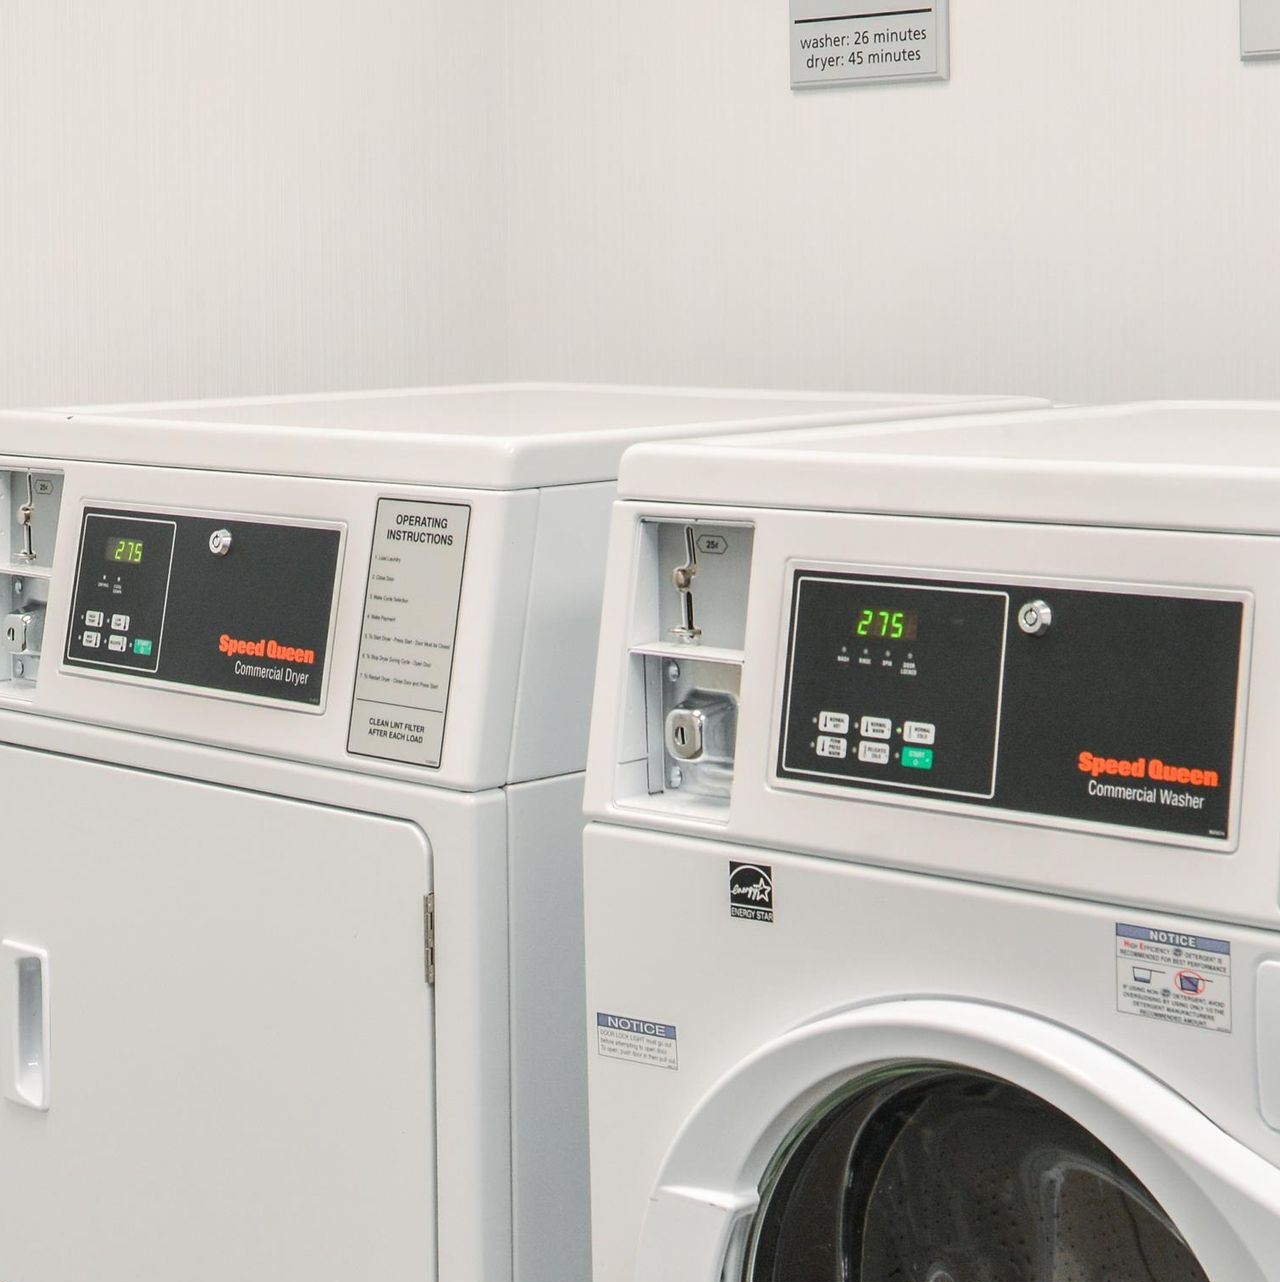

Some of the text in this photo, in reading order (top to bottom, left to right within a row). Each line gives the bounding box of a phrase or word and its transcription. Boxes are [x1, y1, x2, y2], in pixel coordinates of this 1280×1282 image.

[800, 28, 927, 50] washer: 26 minutes
[806, 49, 921, 71] dryer: 45 minutes
[396, 514, 447, 529] OPERATING
[387, 529, 453, 545] INSTRUCTIONS
[115, 541, 143, 562] 275
[857, 610, 903, 638] 275
[219, 634, 314, 664] Speed Queen
[235, 660, 309, 686] Commercial Dryer
[368, 728, 423, 743] AFTER EACH LOAD
[369, 718, 424, 733] CLEAN LINT FILTER
[1078, 752, 1218, 786] Speed Queen
[1089, 780, 1204, 809] Commercial Washer
[731, 907, 773, 920] ENERGY STAR
[1150, 931, 1196, 946] NOTICE
[1185, 952, 1216, 961] DETERGENT
[608, 1017, 666, 1036] NOTICE
